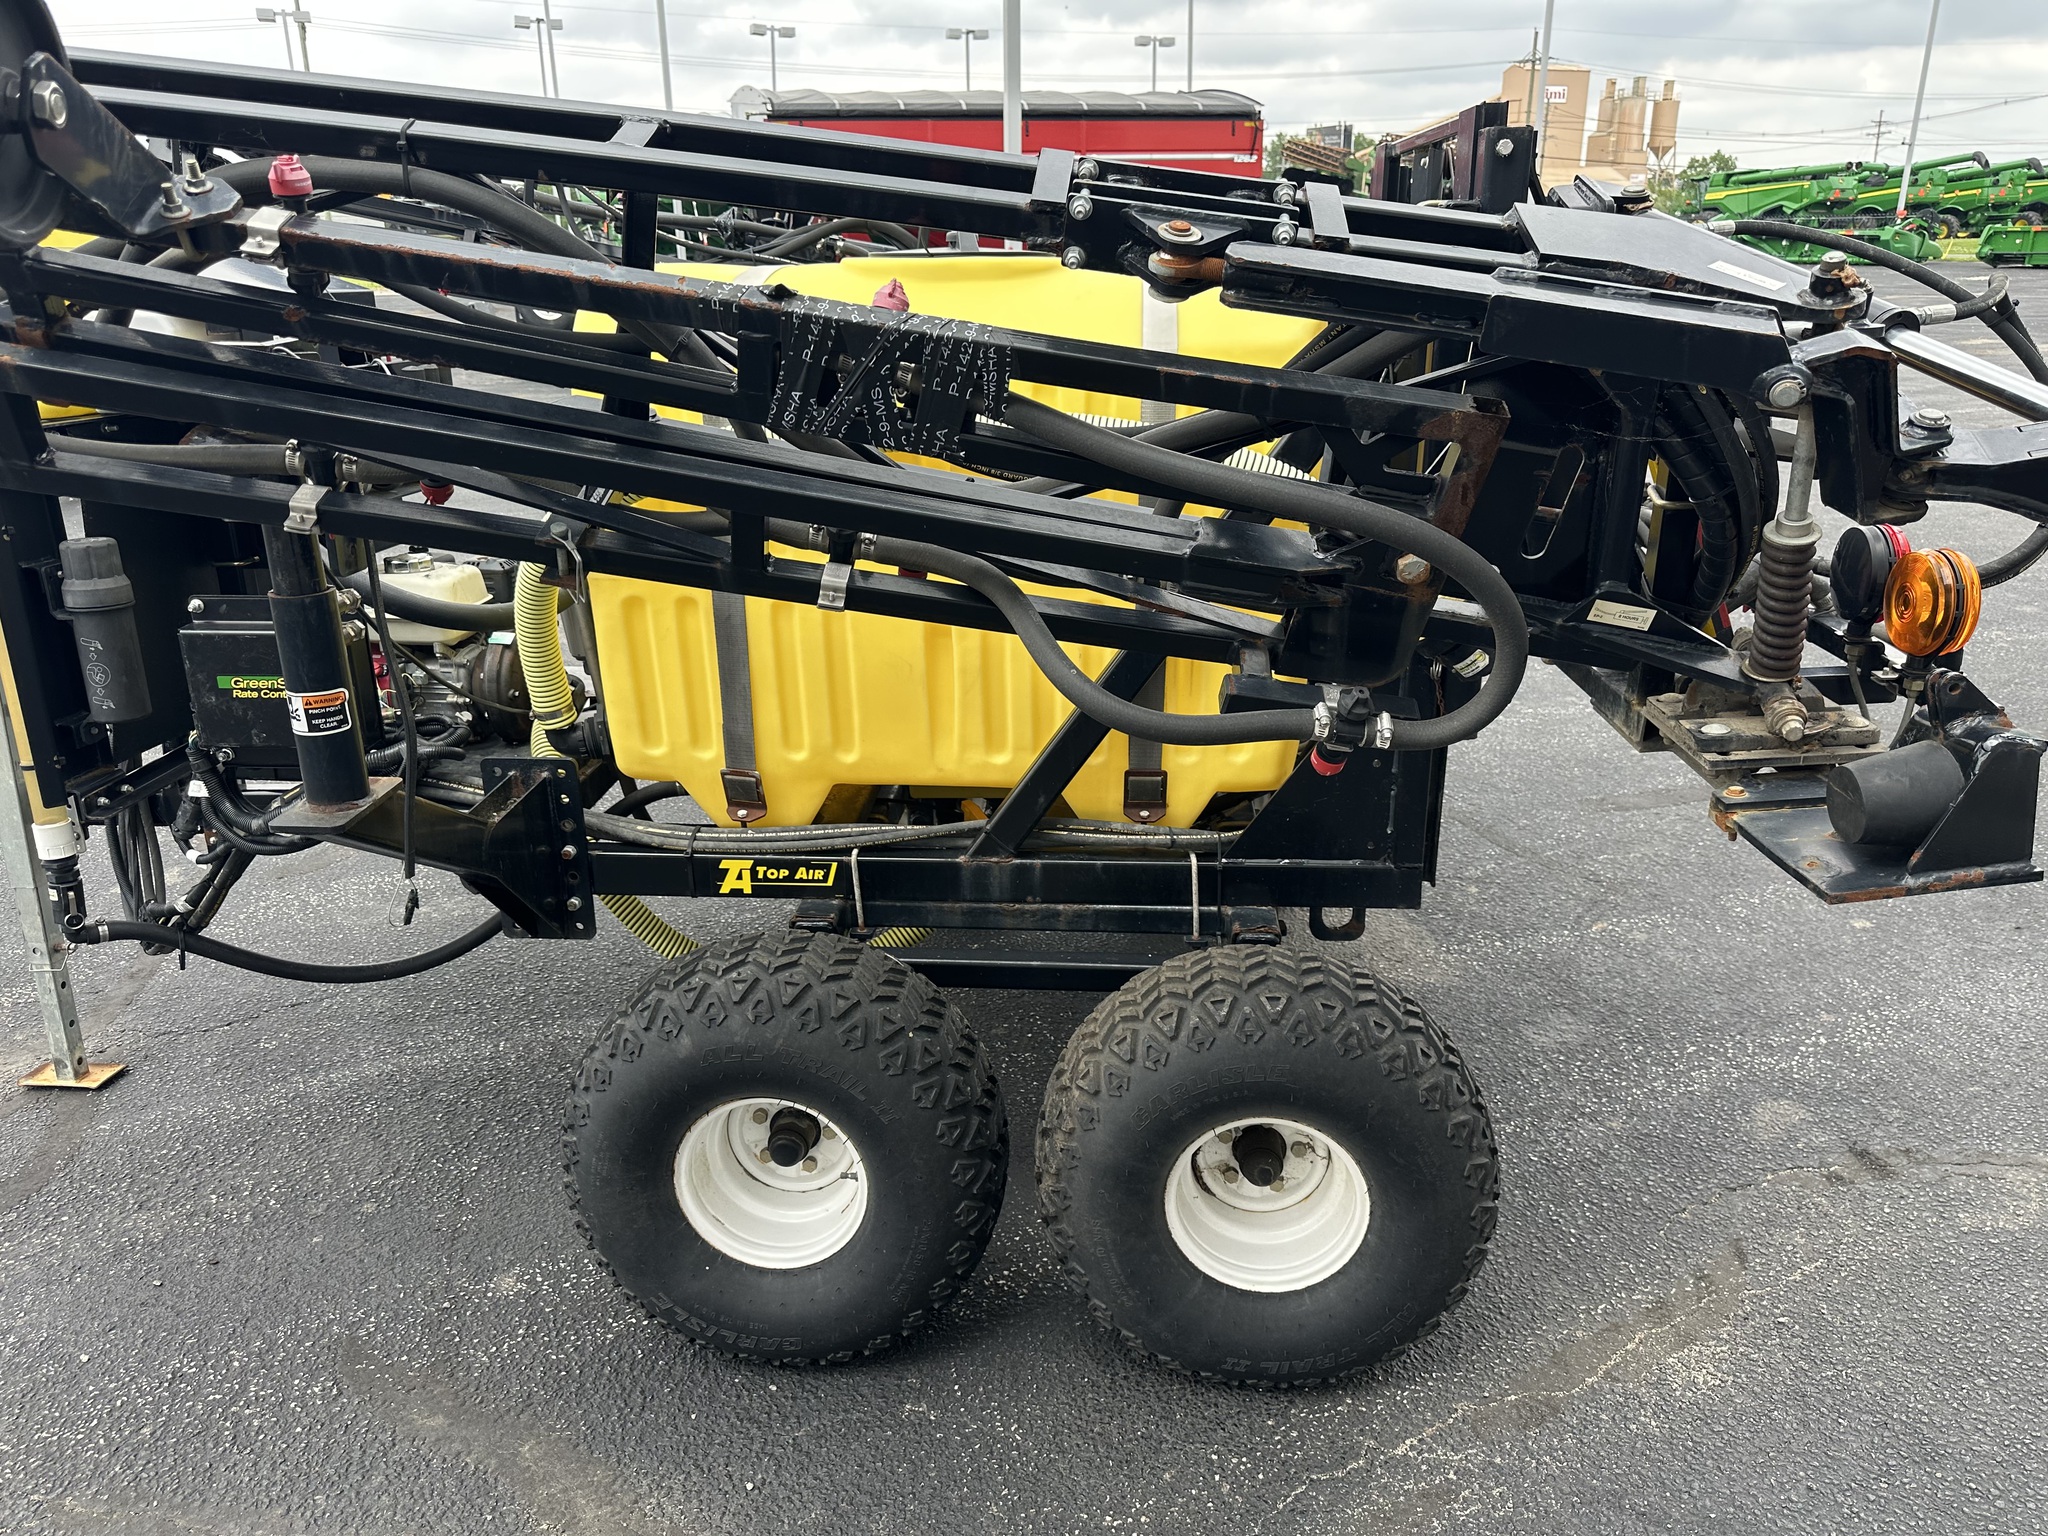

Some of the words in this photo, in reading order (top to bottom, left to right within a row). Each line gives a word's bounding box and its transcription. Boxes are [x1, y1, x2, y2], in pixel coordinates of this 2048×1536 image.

[1545, 88, 1566, 100] imi
[232, 689, 259, 698] Rate
[312, 695, 344, 705] WARNING
[326, 714, 344, 723] HANDS
[756, 866, 790, 879] TOP
[794, 867, 825, 880] AIR
[700, 1043, 764, 1067] ALL
[779, 1047, 867, 1102] TRAIL
[1130, 1064, 1290, 1131] CARLISLE
[650, 1292, 802, 1351] CARLISLE
[1259, 1346, 1357, 1375] TRAIL
